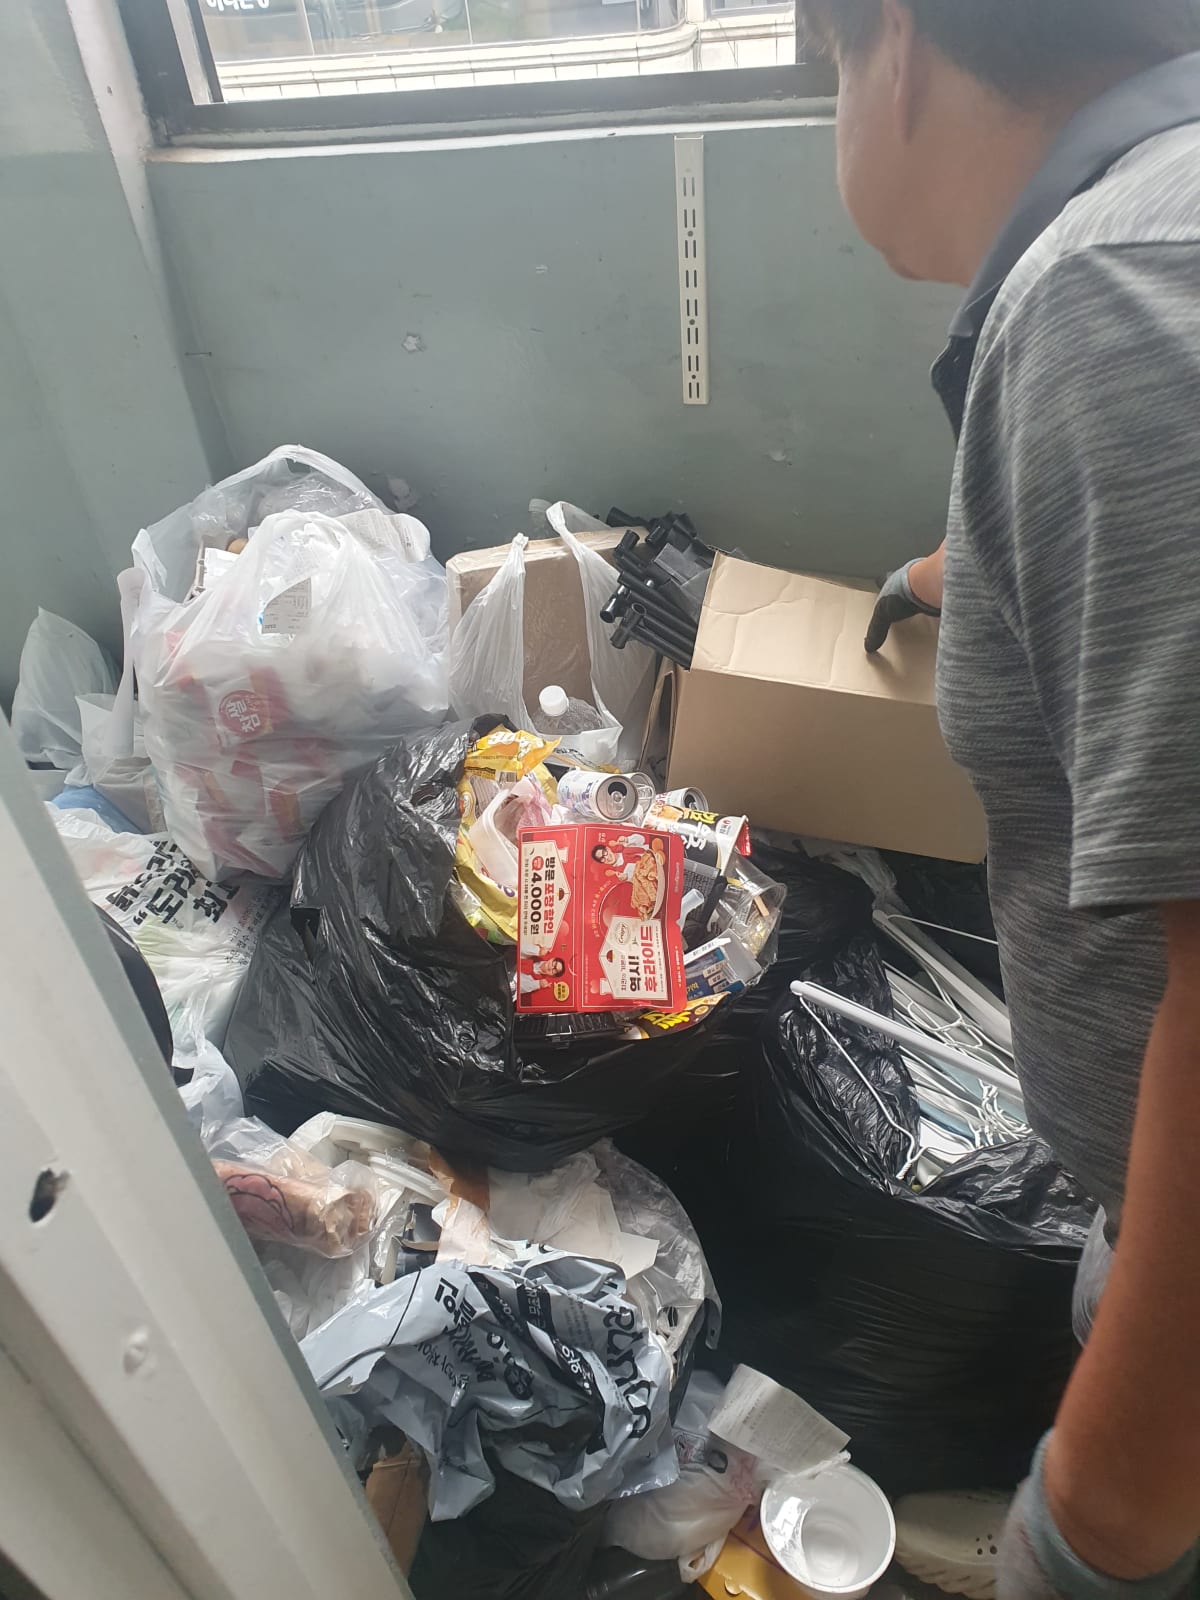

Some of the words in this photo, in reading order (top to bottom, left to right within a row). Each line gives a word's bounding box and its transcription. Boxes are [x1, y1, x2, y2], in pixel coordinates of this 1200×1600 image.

[545, 856, 556, 880] 방문
[628, 955, 641, 992] 역시!
[640, 925, 657, 992] 후라이드
